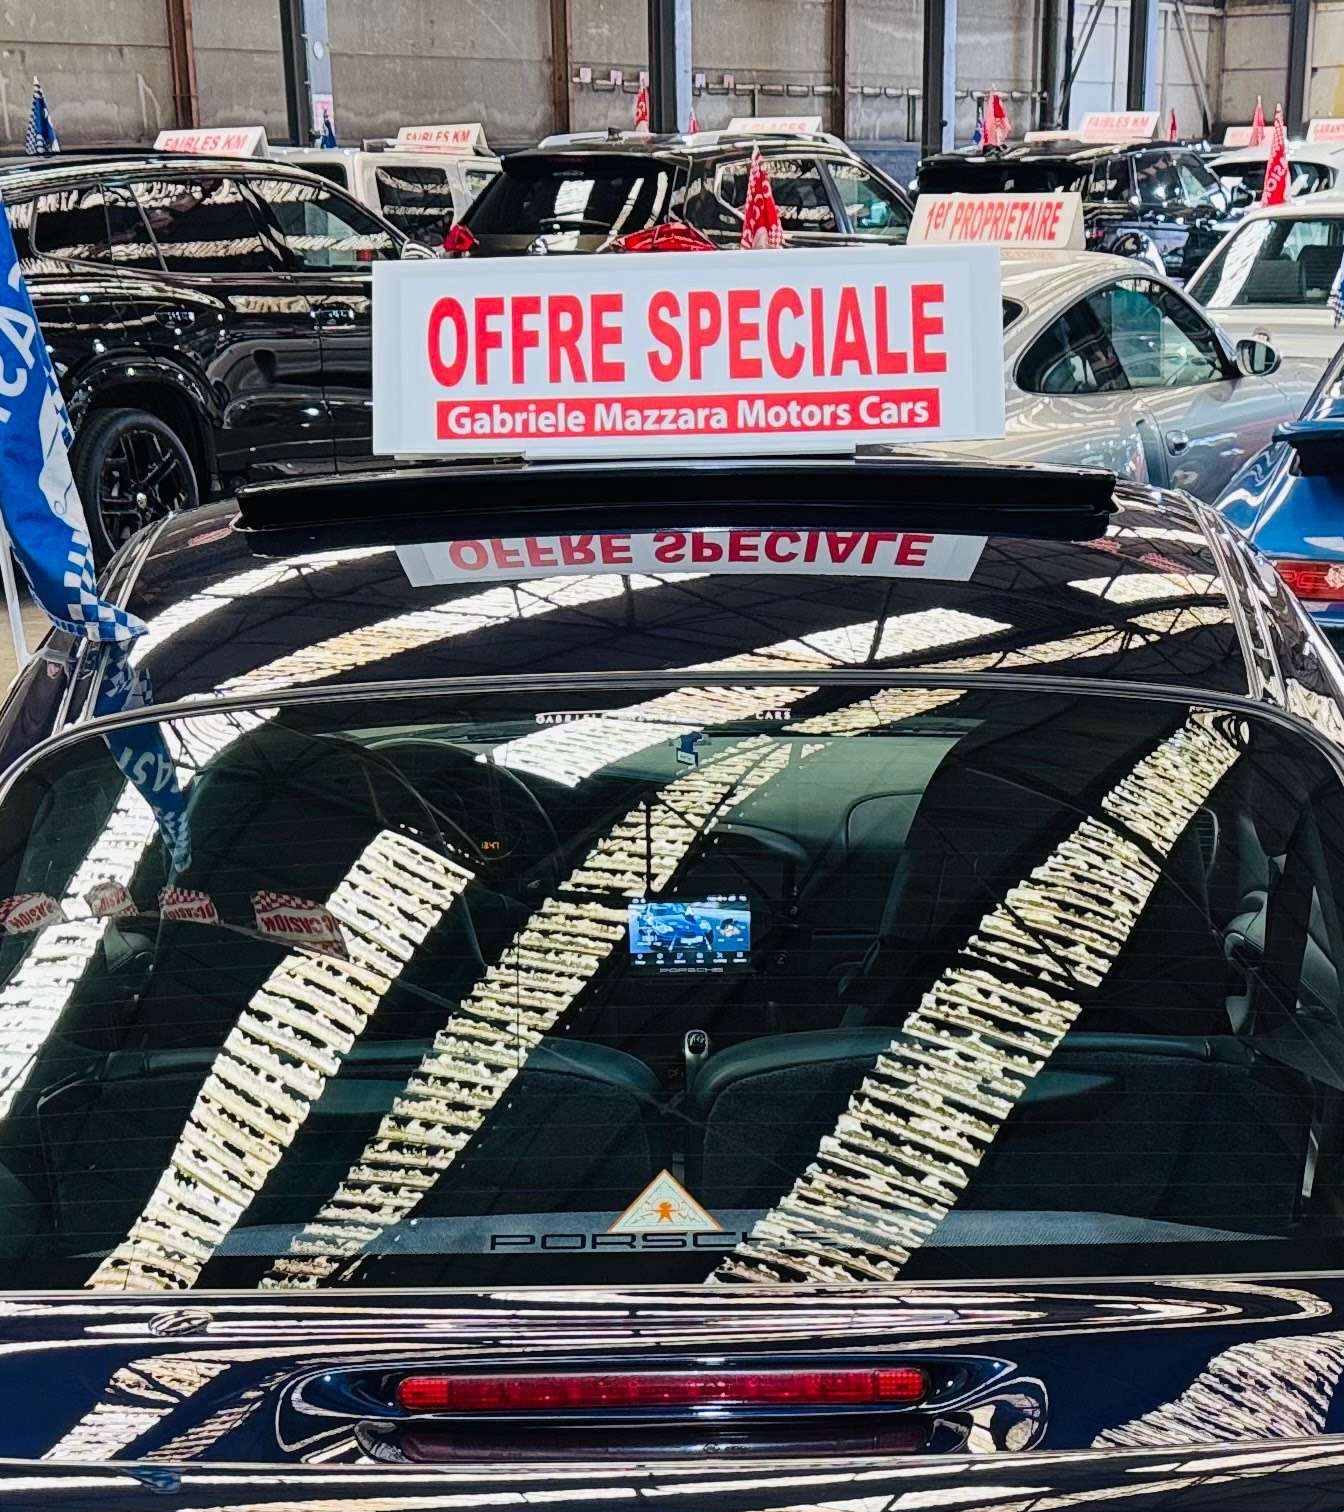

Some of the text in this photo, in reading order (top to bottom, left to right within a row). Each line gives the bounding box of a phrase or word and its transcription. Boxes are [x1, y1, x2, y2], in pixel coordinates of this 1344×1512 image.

[925, 200, 1064, 241] 1er PROPRIETAIRE
[427, 284, 948, 388] OFFRE SPECIALE
[448, 394, 929, 436] Gabriele Mazzara Motors Cars
[756, 711, 791, 720] CARS
